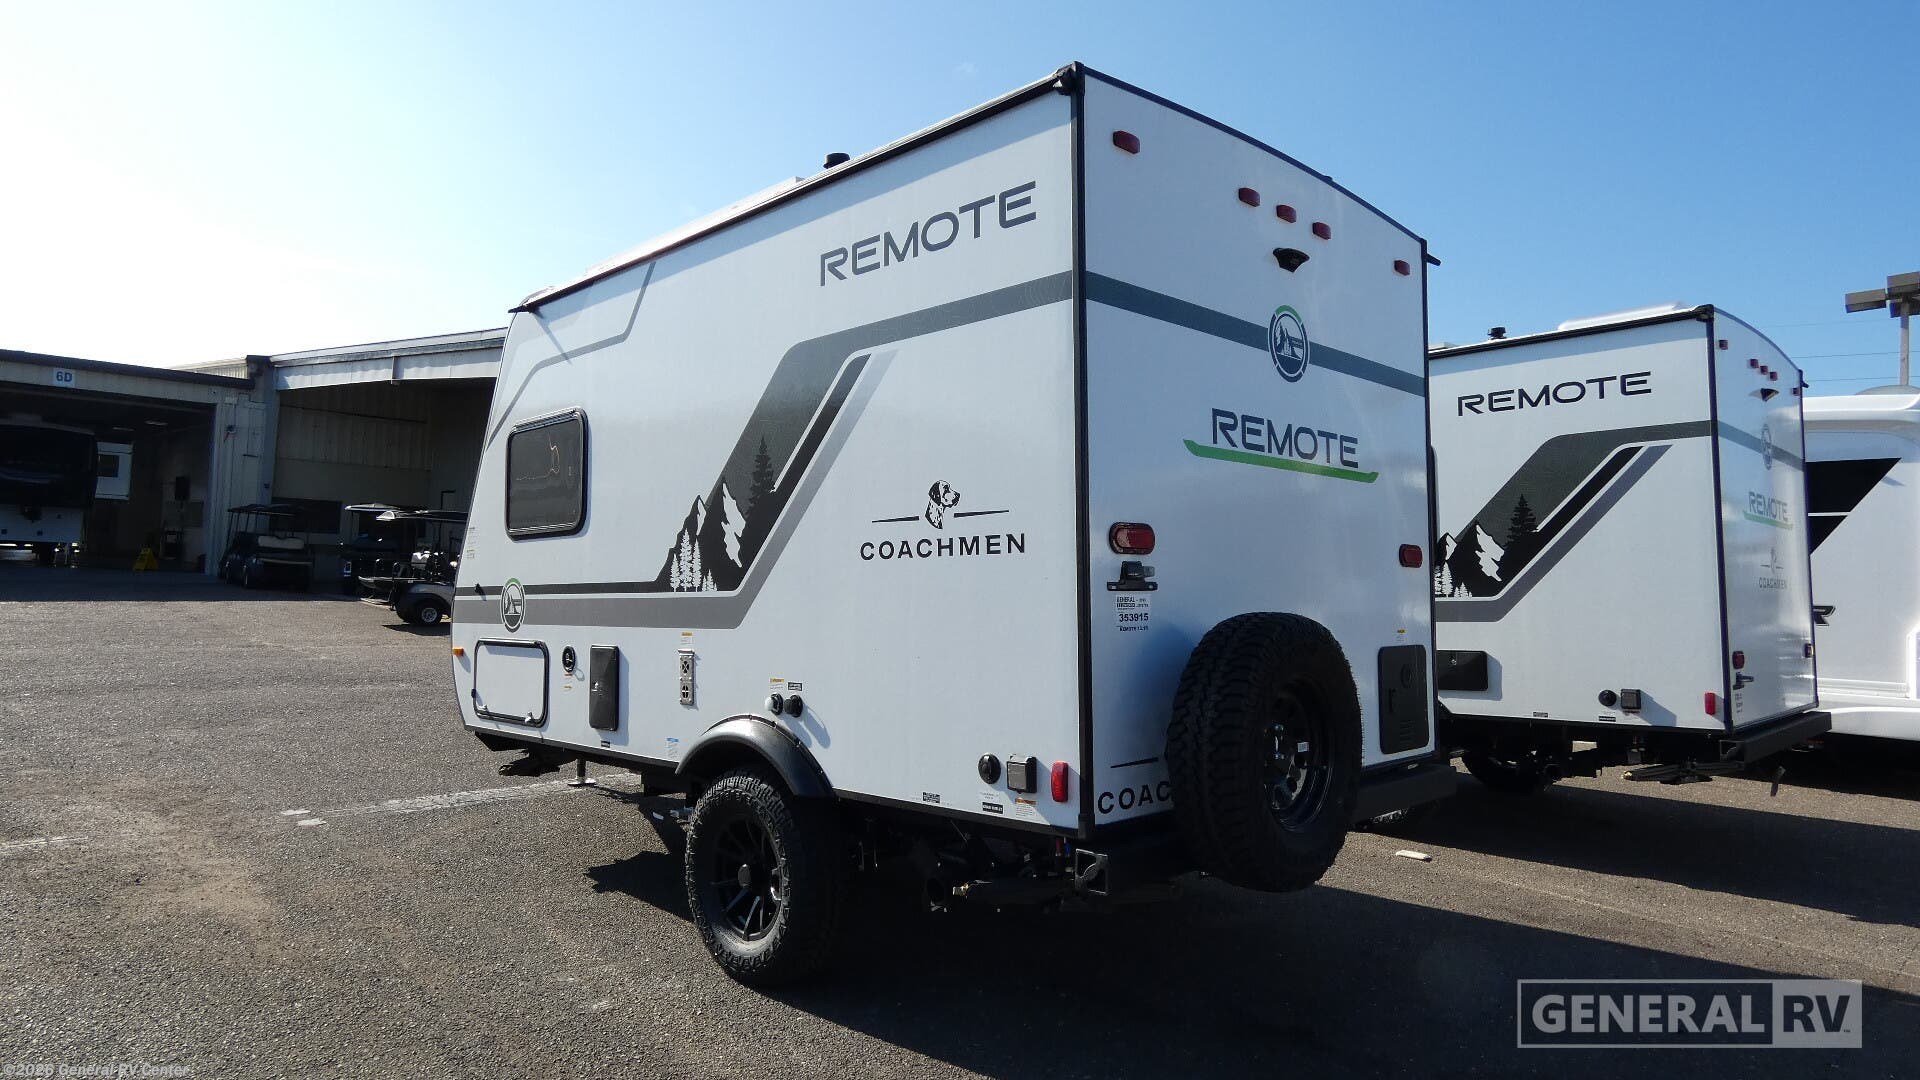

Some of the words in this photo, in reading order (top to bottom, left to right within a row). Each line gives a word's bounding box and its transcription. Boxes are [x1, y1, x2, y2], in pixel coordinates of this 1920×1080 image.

[820, 181, 1037, 287] REMOTE
[56, 371, 73, 382] 6D
[1458, 371, 1652, 416] REMOTE
[1211, 407, 1359, 469] REMOTE
[1748, 490, 1788, 522] REMOTE
[860, 533, 1026, 561] COACHMEN
[1119, 613, 1149, 622] 353915
[1097, 781, 1170, 815] COAC
